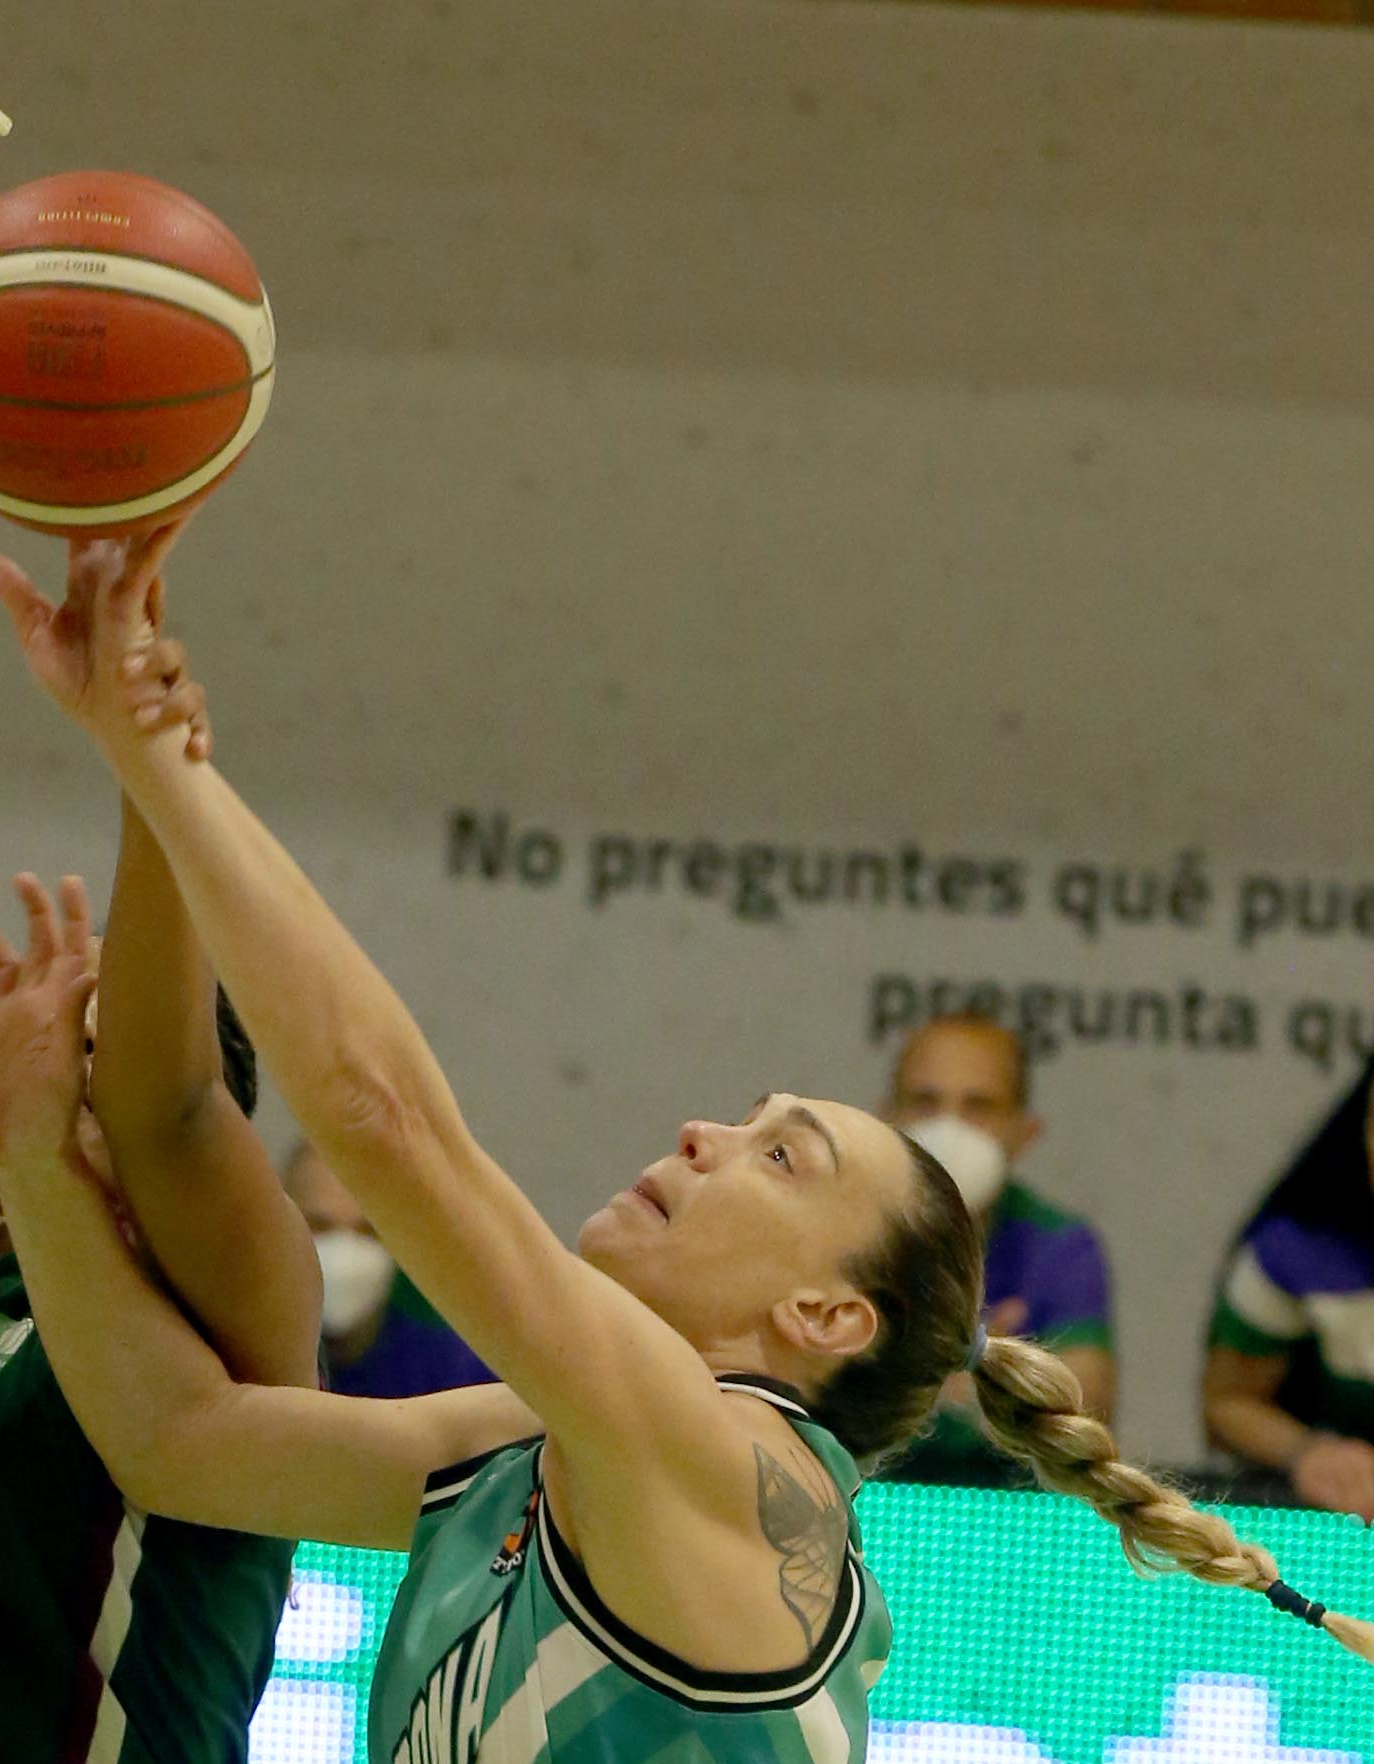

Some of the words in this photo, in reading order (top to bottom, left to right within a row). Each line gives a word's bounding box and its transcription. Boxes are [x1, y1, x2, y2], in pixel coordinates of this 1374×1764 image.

[445, 806, 564, 890] No
[583, 830, 1028, 926] preguntes
[1053, 846, 1214, 938] qué
